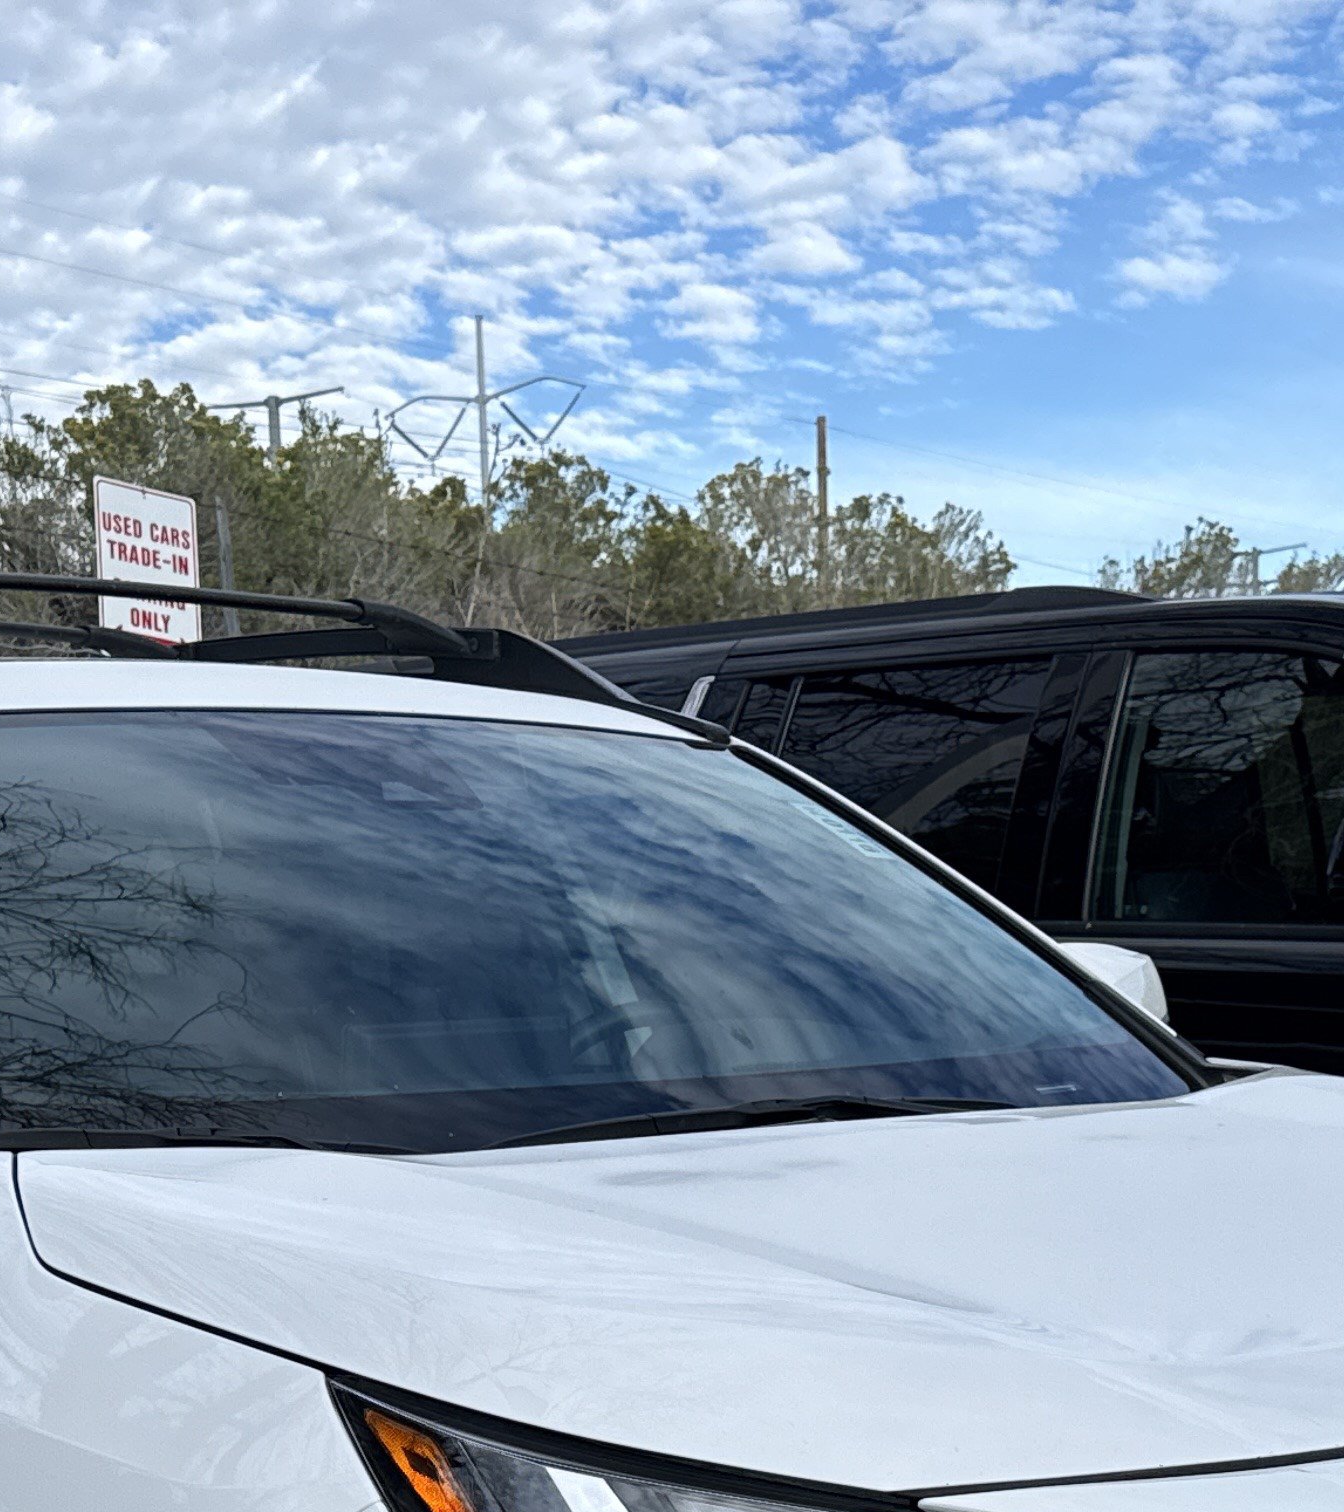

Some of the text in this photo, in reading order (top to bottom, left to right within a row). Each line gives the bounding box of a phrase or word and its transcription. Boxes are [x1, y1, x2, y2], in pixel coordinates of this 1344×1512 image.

[102, 512, 190, 549] USED CARS
[106, 540, 189, 576] TRADE-IN
[130, 608, 170, 633] ONLY
